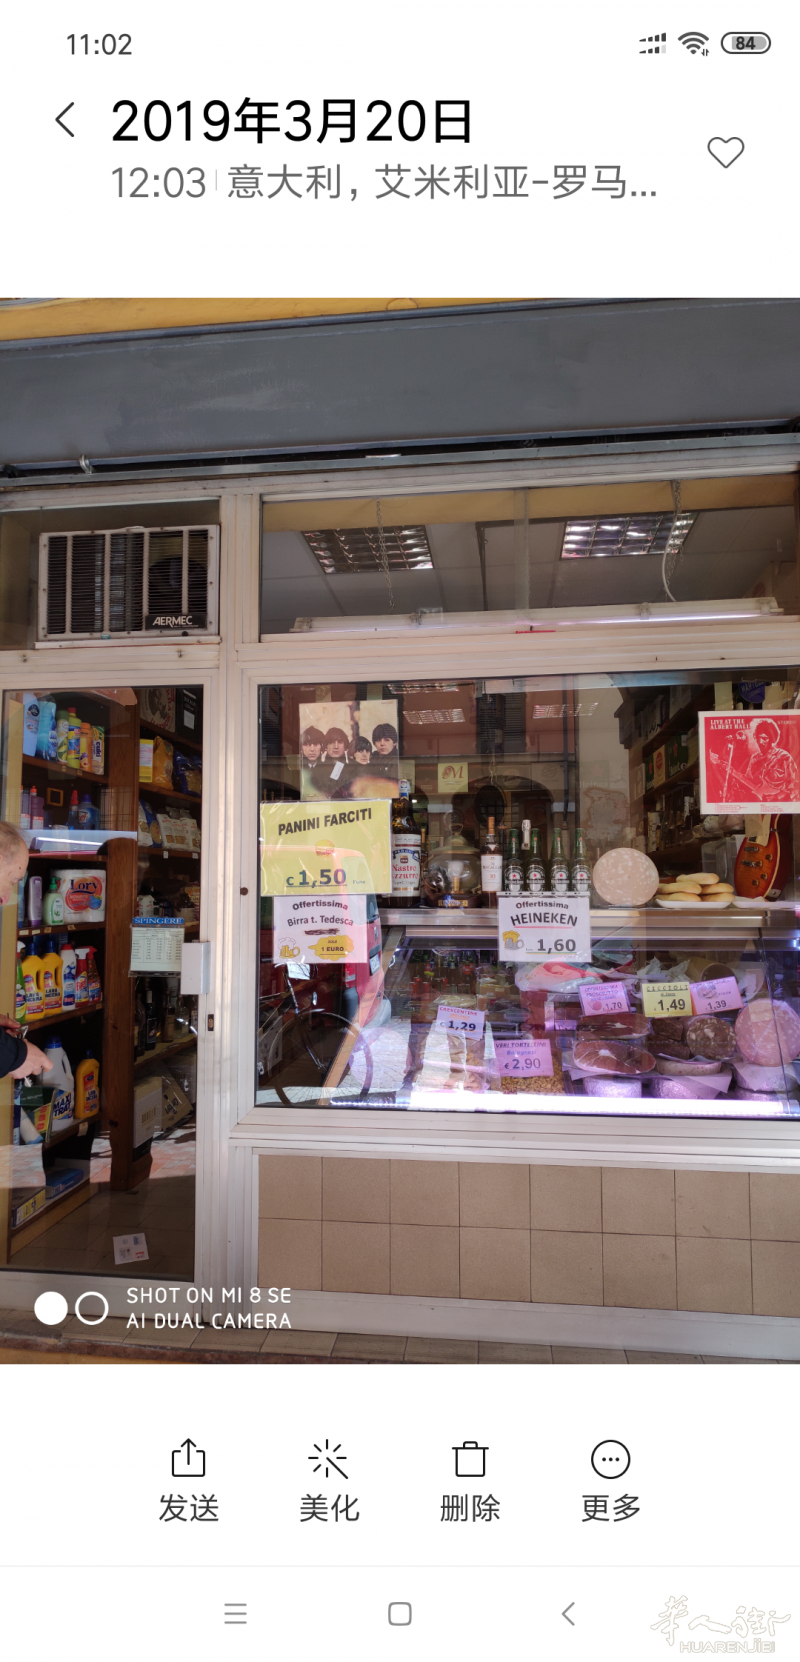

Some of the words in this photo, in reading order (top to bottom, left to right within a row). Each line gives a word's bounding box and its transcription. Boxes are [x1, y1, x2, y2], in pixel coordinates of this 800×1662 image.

[152, 615, 193, 628] AERMEC
[278, 817, 320, 836] PANINI
[324, 807, 372, 828] FARCITI
[298, 868, 347, 889] 1,50
[70, 879, 99, 892] Lory
[292, 900, 349, 911] Offertissima
[515, 901, 569, 909] Offertissima
[287, 917, 309, 927] Birra
[311, 916, 318, 924] t.
[319, 915, 354, 926] Tedesca
[510, 912, 578, 927] HEINEKEN
[537, 938, 577, 954] 1,60
[605, 1001, 622, 1010] 1,70
[657, 998, 686, 1012] 1,49
[707, 999, 727, 1010] 1,39
[448, 1020, 477, 1031] 1,29
[512, 1058, 541, 1071] 2,90
[53, 1092, 71, 1110] MAXI
